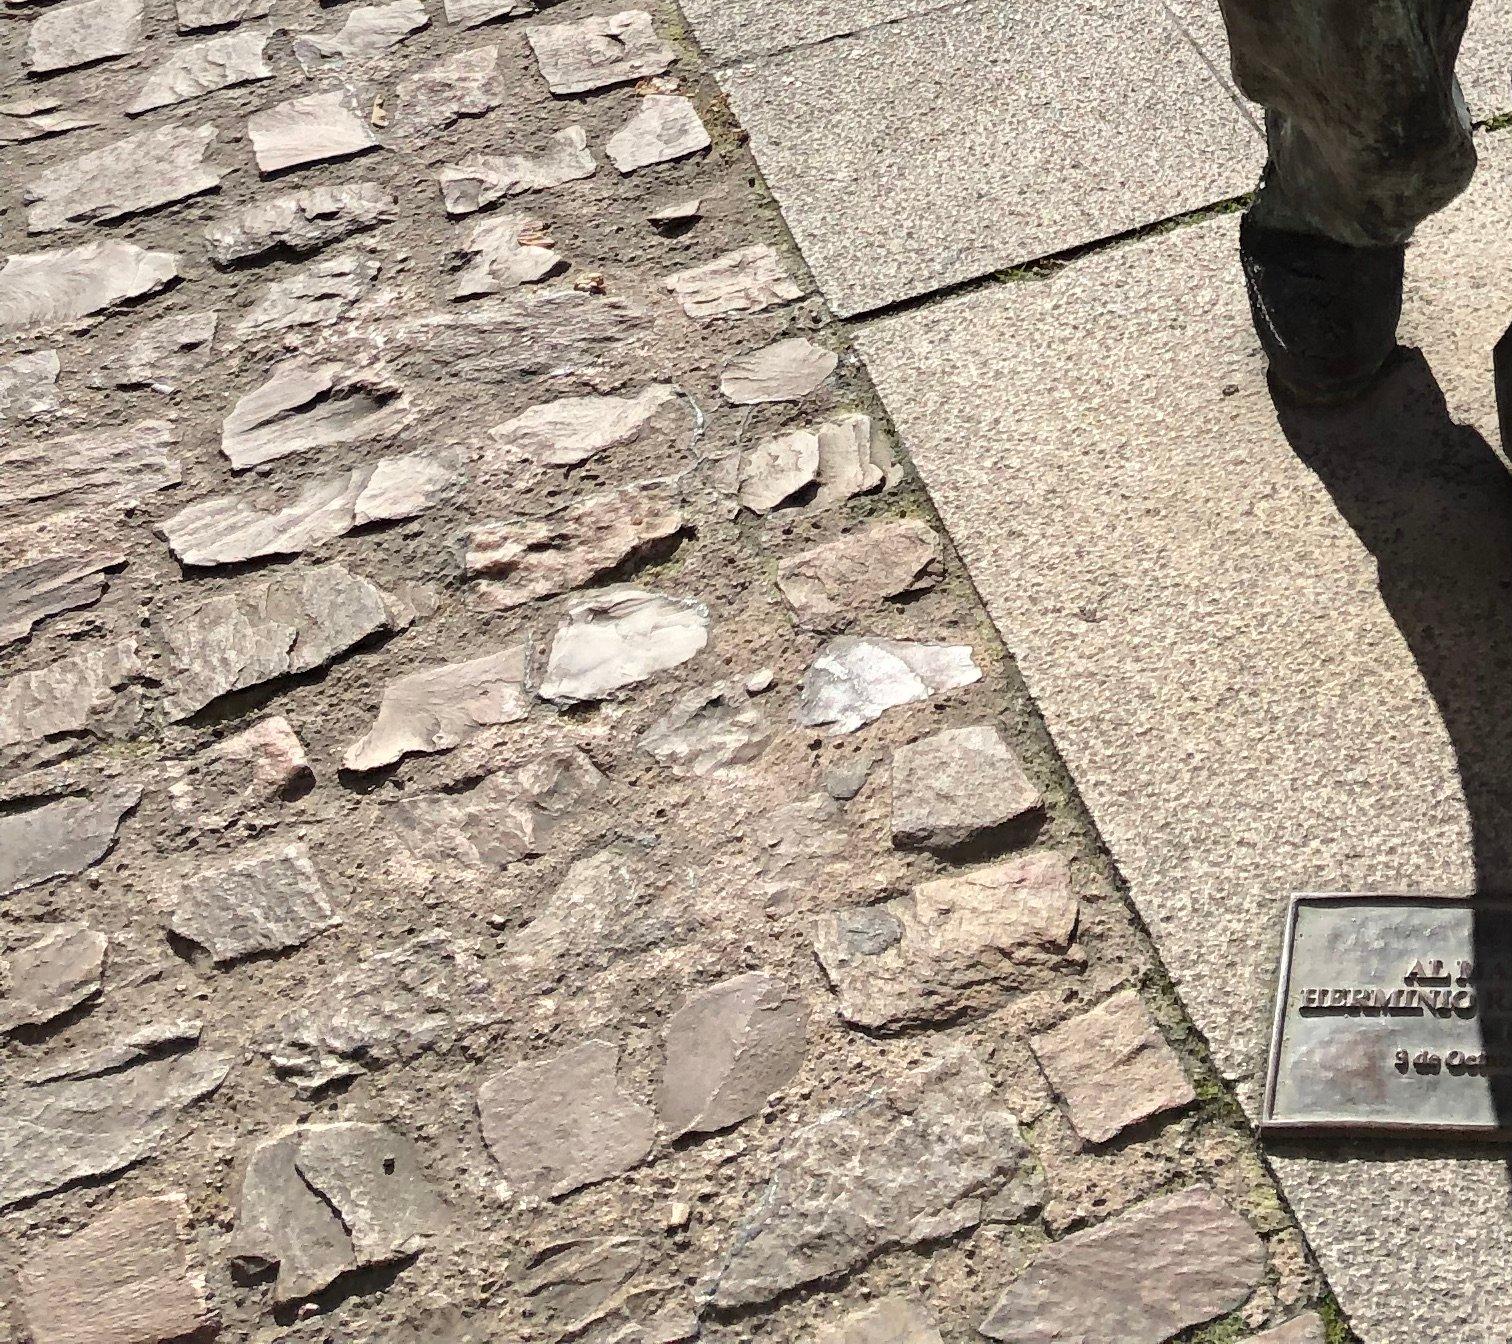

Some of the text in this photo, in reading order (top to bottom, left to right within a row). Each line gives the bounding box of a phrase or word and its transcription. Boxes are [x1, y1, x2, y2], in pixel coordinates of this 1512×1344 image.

[1403, 959, 1452, 987] AL
[1299, 989, 1478, 1019] HERMINIO
[1413, 1050, 1442, 1075] de
